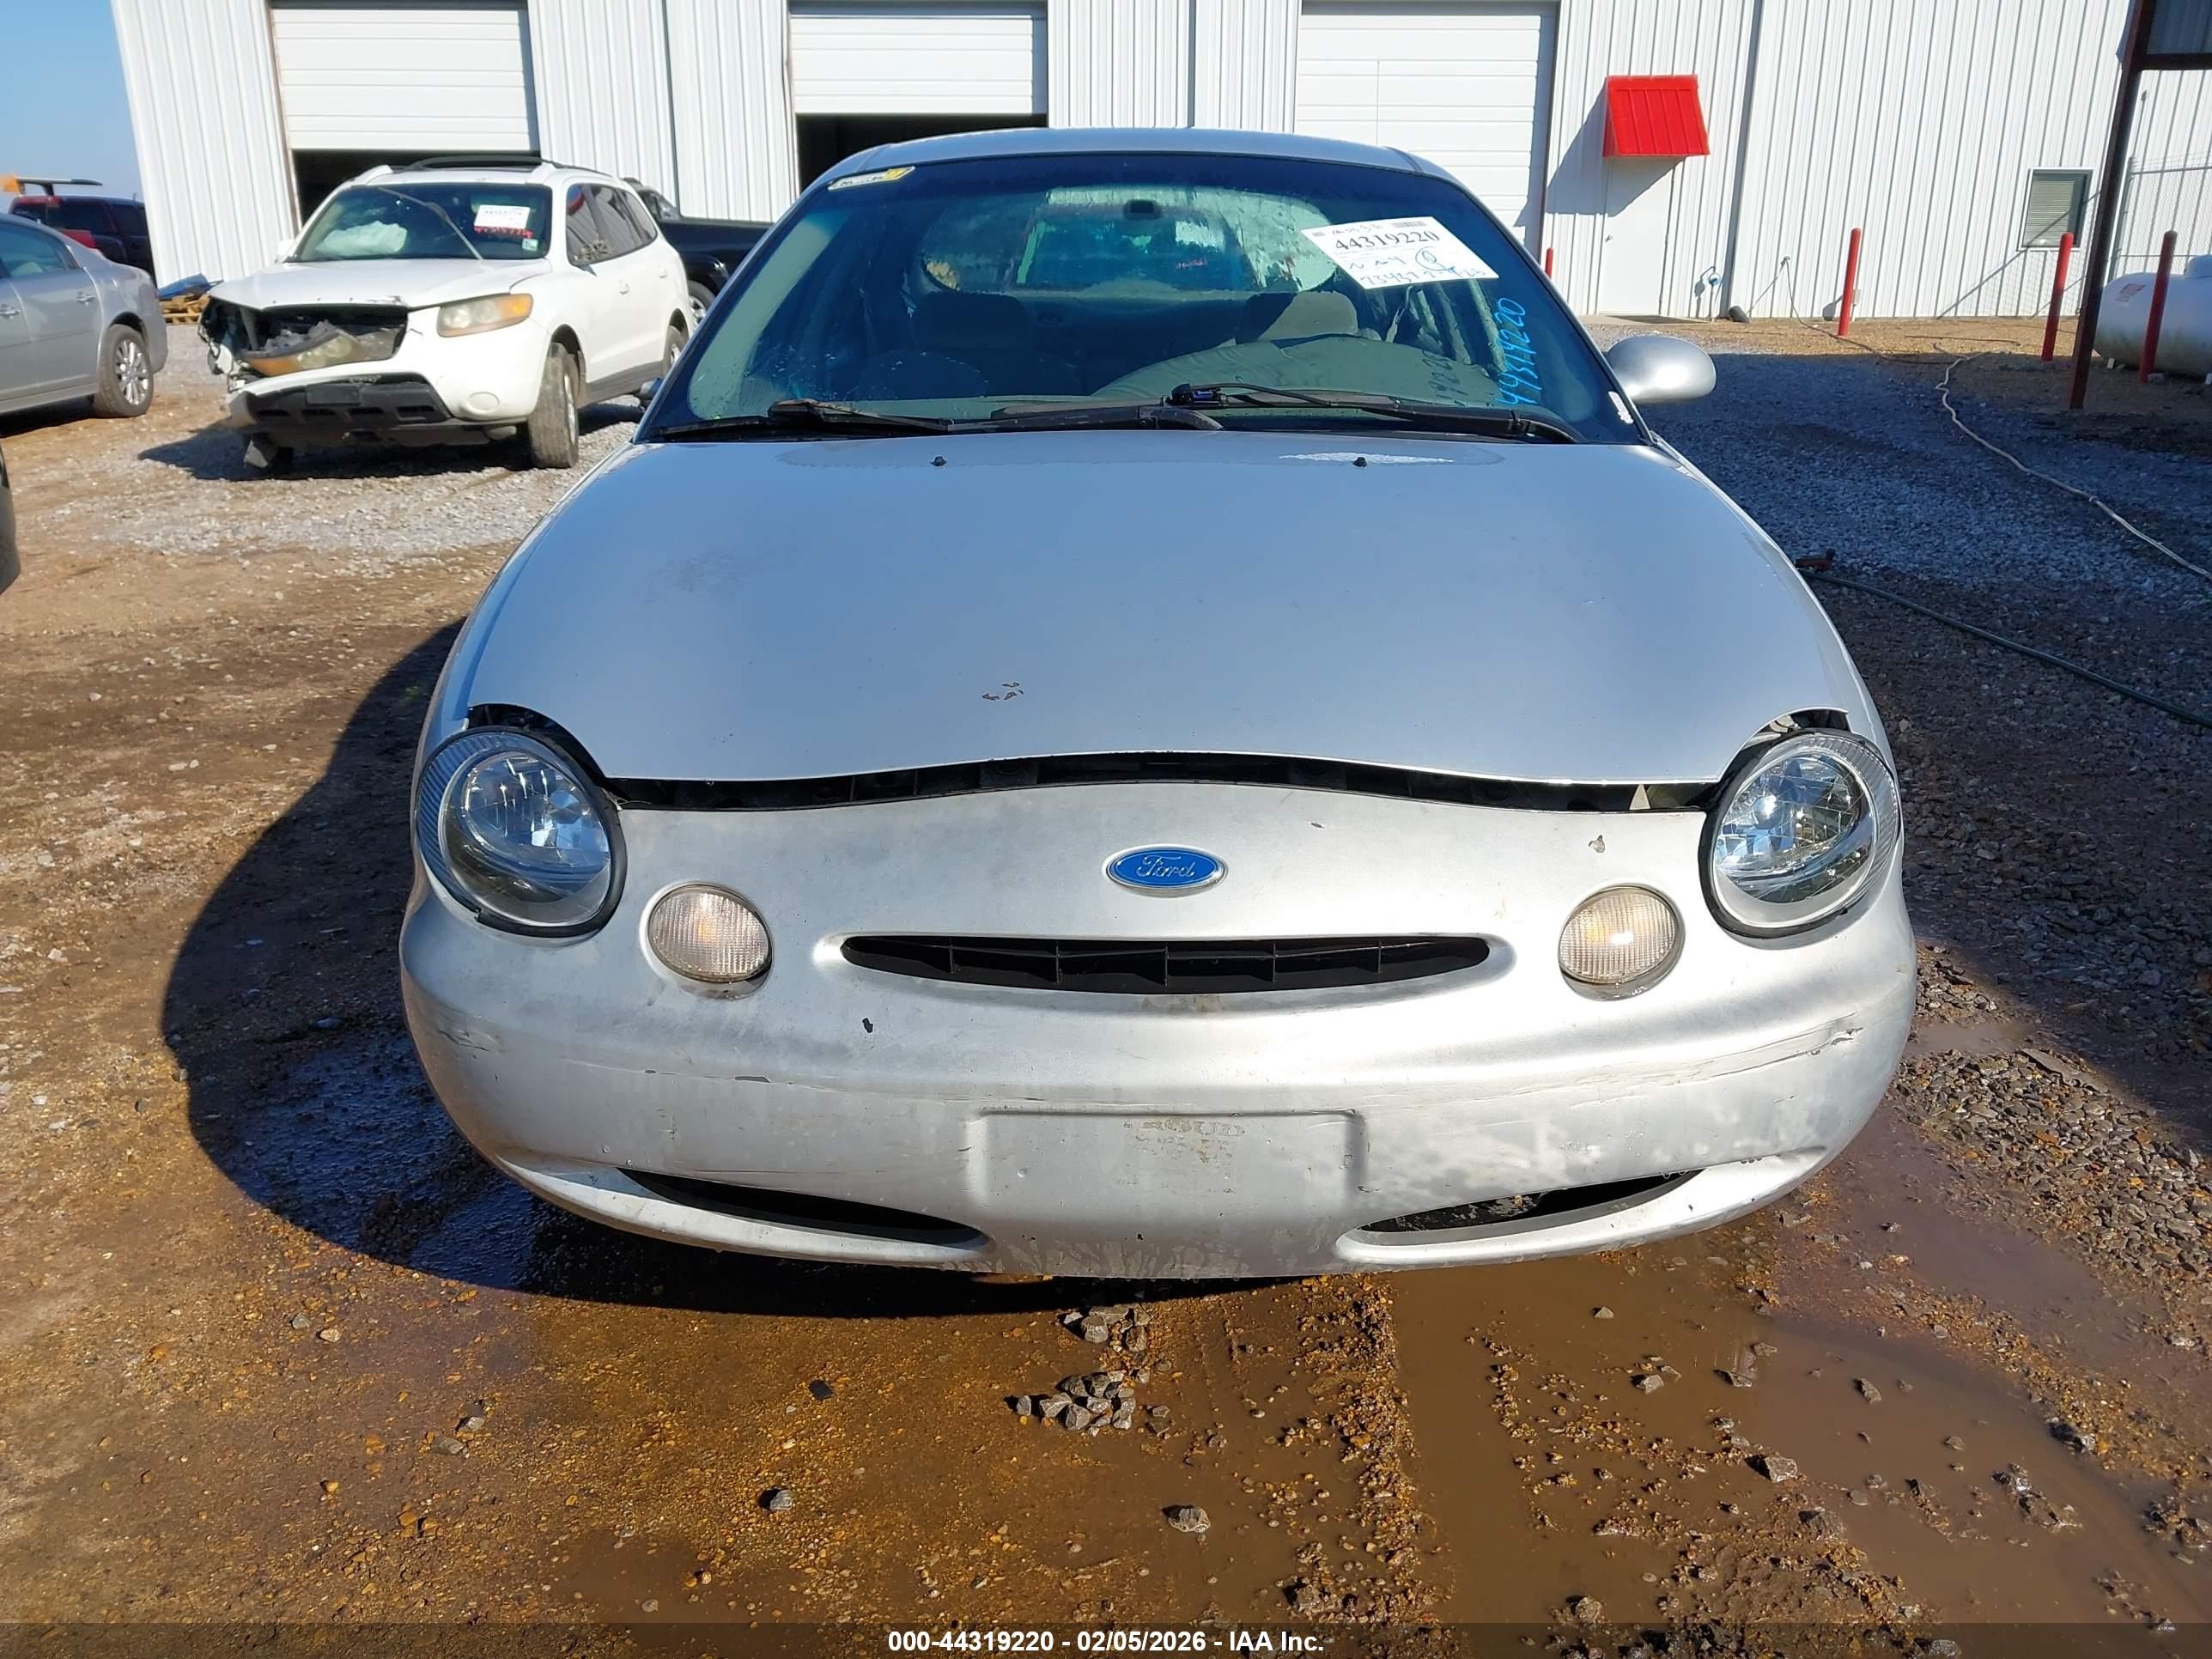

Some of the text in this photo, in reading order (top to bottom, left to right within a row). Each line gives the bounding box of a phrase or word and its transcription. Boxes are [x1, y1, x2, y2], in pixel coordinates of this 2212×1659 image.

[1335, 230, 1440, 250] 44319220
[1494, 297, 1543, 406] 44319220
[1136, 855, 1195, 877] Ford
